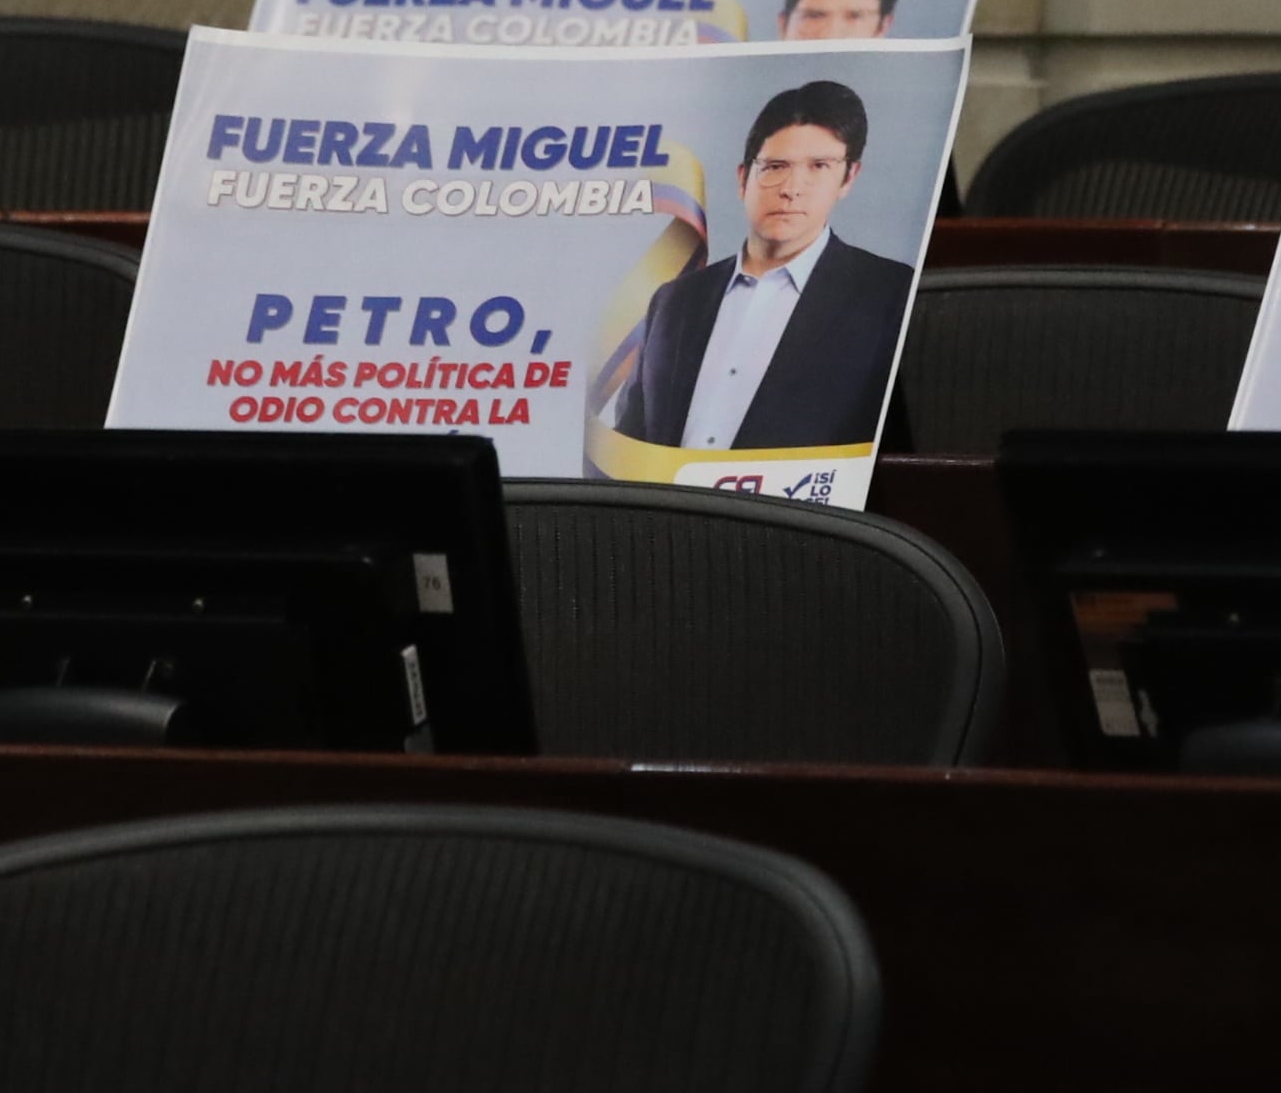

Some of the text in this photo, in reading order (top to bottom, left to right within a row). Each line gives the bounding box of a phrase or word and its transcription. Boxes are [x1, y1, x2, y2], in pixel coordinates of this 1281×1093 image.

[296, 11, 698, 47] FUERZA COLOMBIA
[206, 114, 670, 171] FUERZA MIGUEL
[207, 170, 655, 217] FUERZA COLOMBIA
[246, 293, 552, 355] PETRO,
[207, 354, 571, 389] NO MÁS POLÍTICA DE
[229, 396, 530, 425] ODIO CONTRA LA
[810, 486, 831, 497] LO
